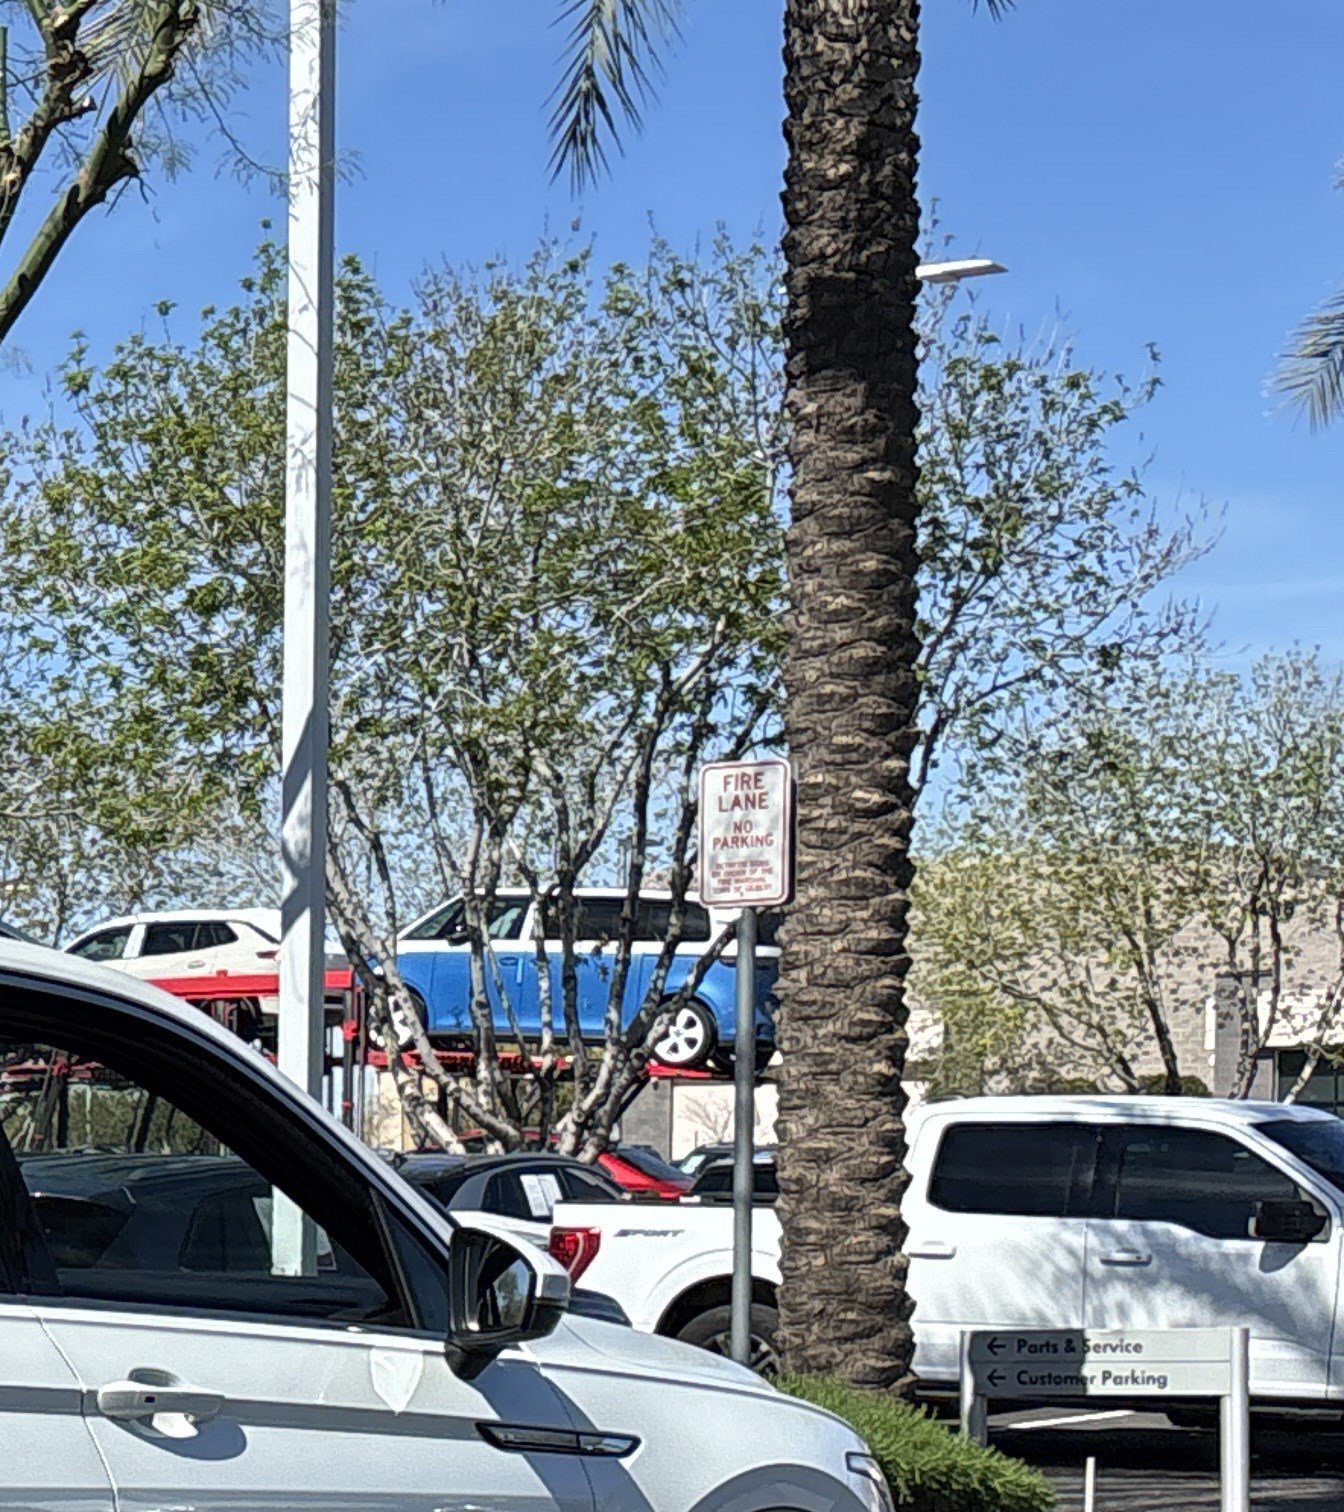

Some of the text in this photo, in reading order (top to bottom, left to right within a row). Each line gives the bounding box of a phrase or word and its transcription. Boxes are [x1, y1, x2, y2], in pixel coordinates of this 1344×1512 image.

[723, 772, 765, 792] FIRE
[718, 791, 769, 812] LANE
[732, 819, 753, 834] NO
[712, 833, 774, 852] PARKING
[1016, 1338, 1143, 1354] Parts & Service
[1016, 1369, 1169, 1389] Customer Parking
